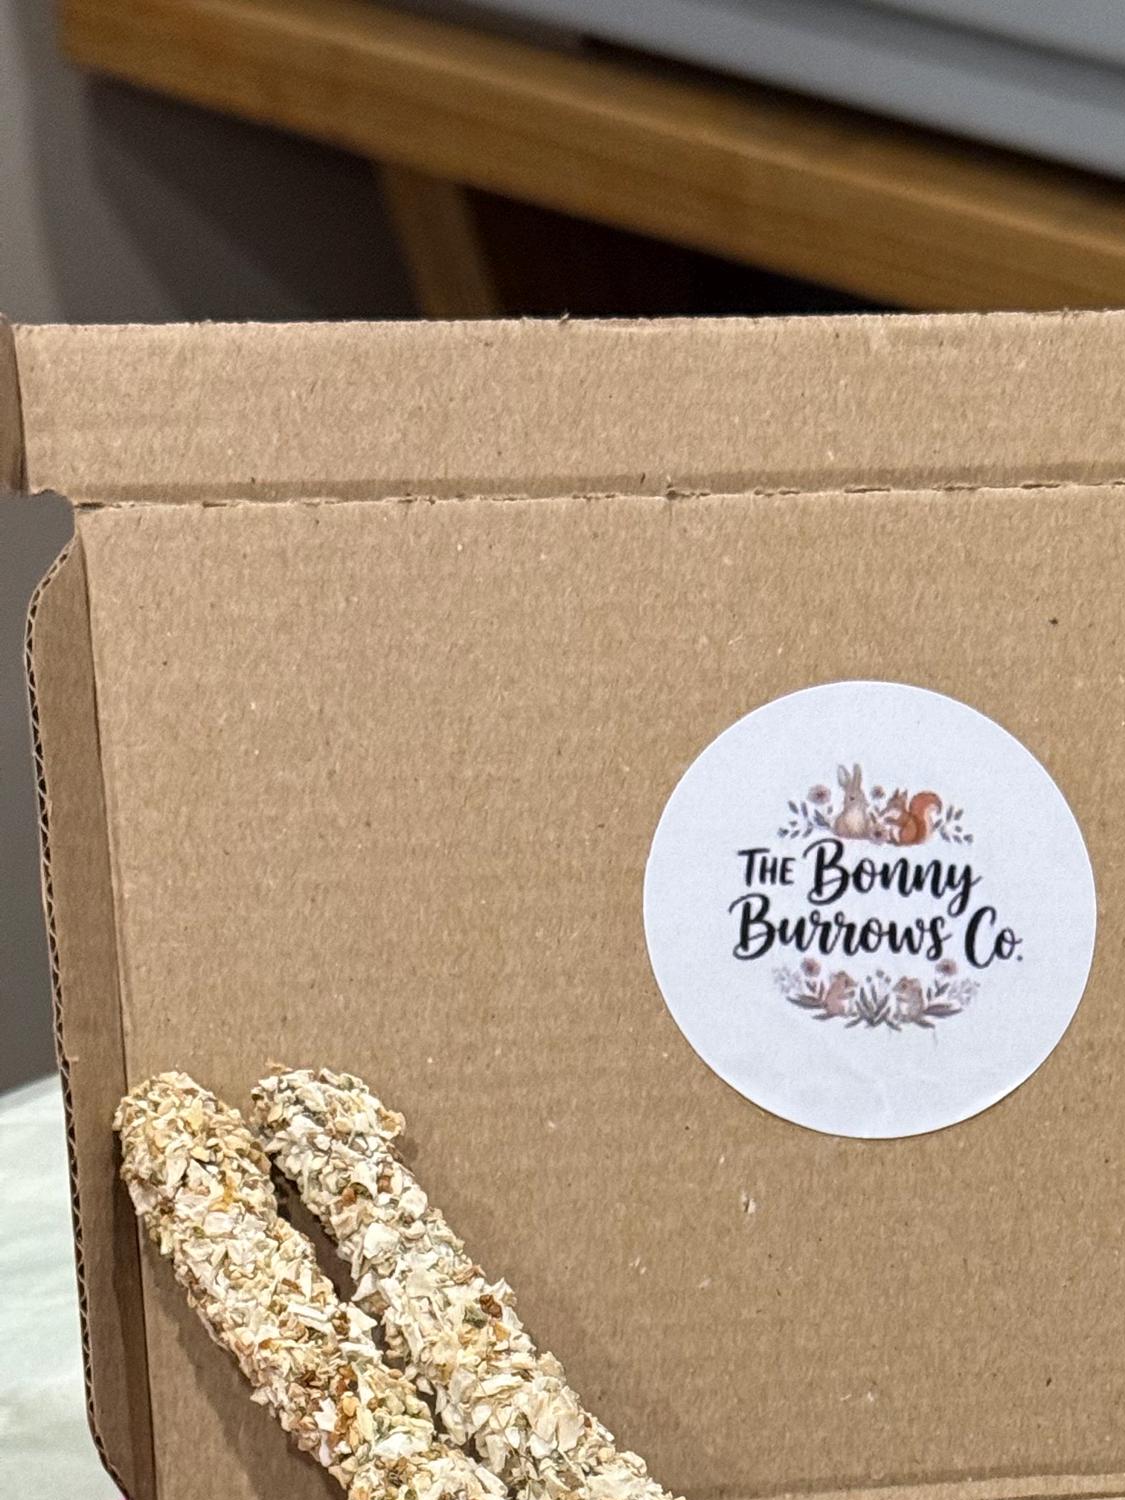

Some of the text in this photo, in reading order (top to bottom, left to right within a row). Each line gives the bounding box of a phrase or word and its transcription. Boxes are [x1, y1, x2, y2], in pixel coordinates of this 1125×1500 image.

[738, 838, 981, 917] THE Bonny
[728, 893, 1023, 969] Burrows Co.
